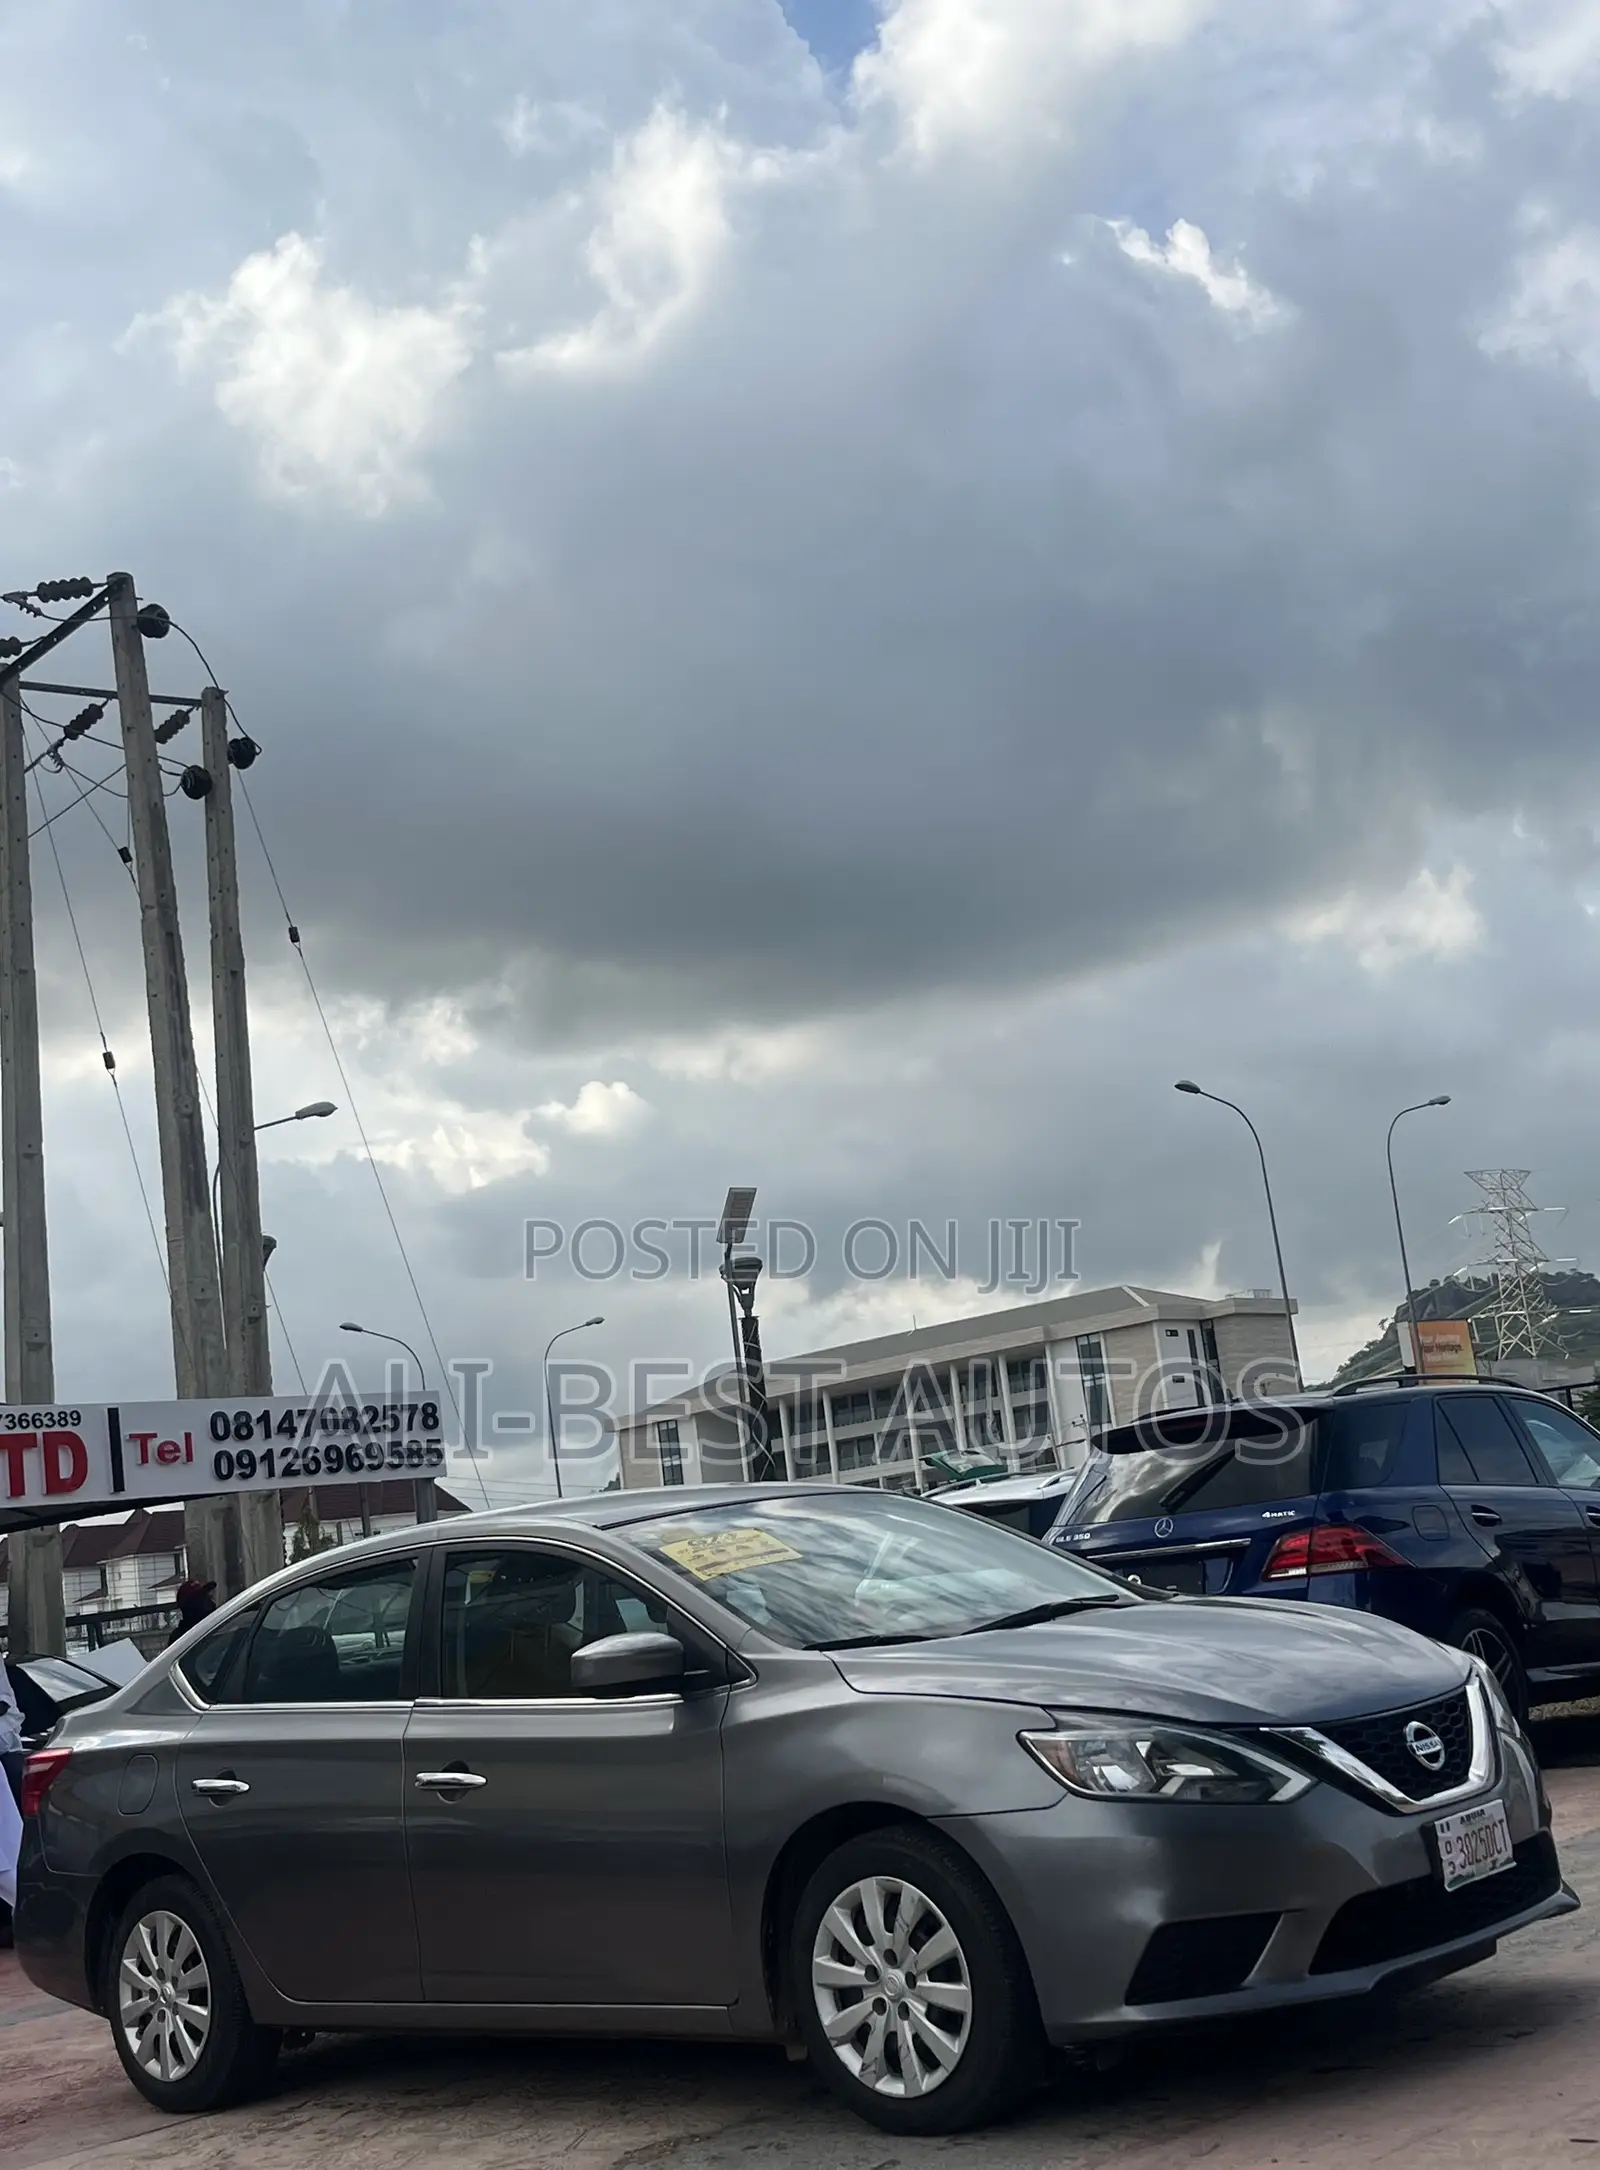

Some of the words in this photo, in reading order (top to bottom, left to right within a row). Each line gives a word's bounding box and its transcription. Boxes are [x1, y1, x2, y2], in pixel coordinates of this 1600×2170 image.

[0, 1409, 82, 1431] 366389
[210, 1401, 440, 1442] 08147082578
[128, 1431, 194, 1465] Tel
[214, 1438, 444, 1481] 09126969585
